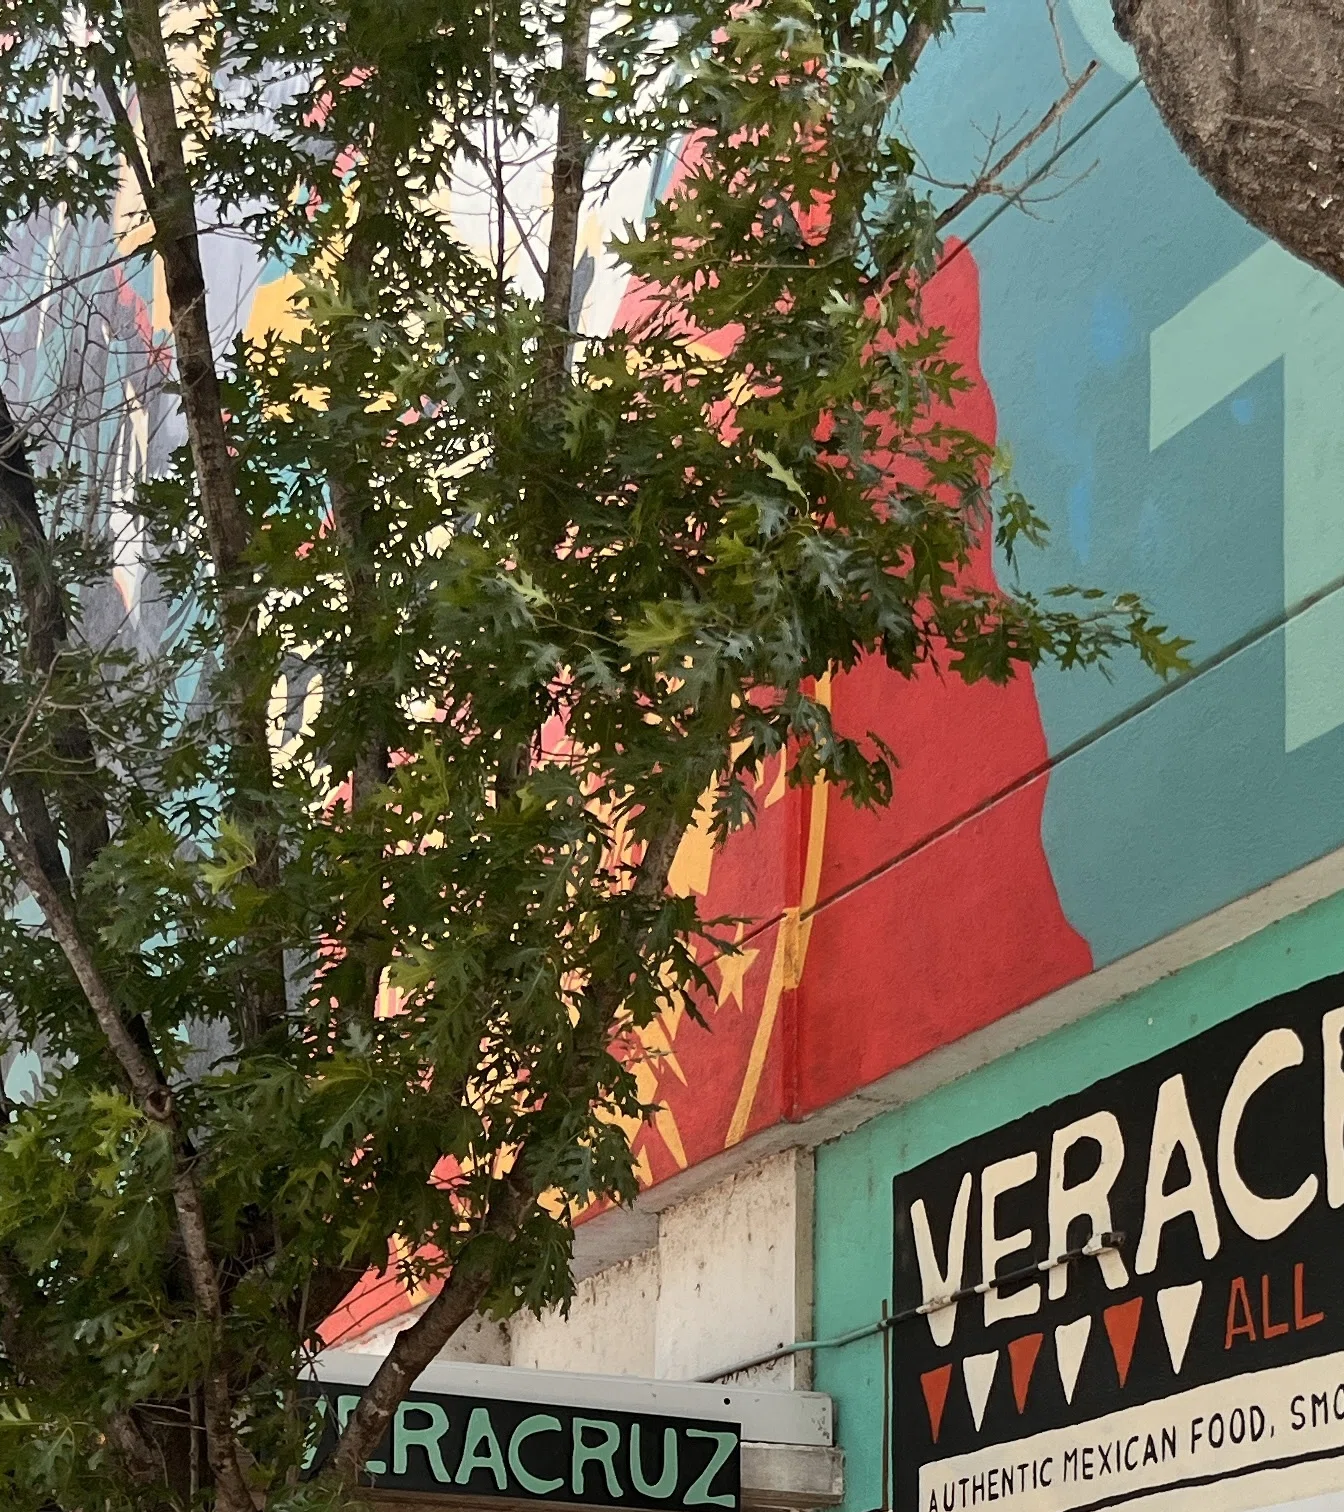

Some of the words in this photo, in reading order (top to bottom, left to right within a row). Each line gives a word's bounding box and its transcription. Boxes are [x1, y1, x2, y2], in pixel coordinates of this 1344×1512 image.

[1224, 1262, 1325, 1350] ALL
[275, 1389, 739, 1508] RACRUZ
[1062, 1424, 1177, 1483] MEXICAN
[1191, 1405, 1275, 1455] FOOD,
